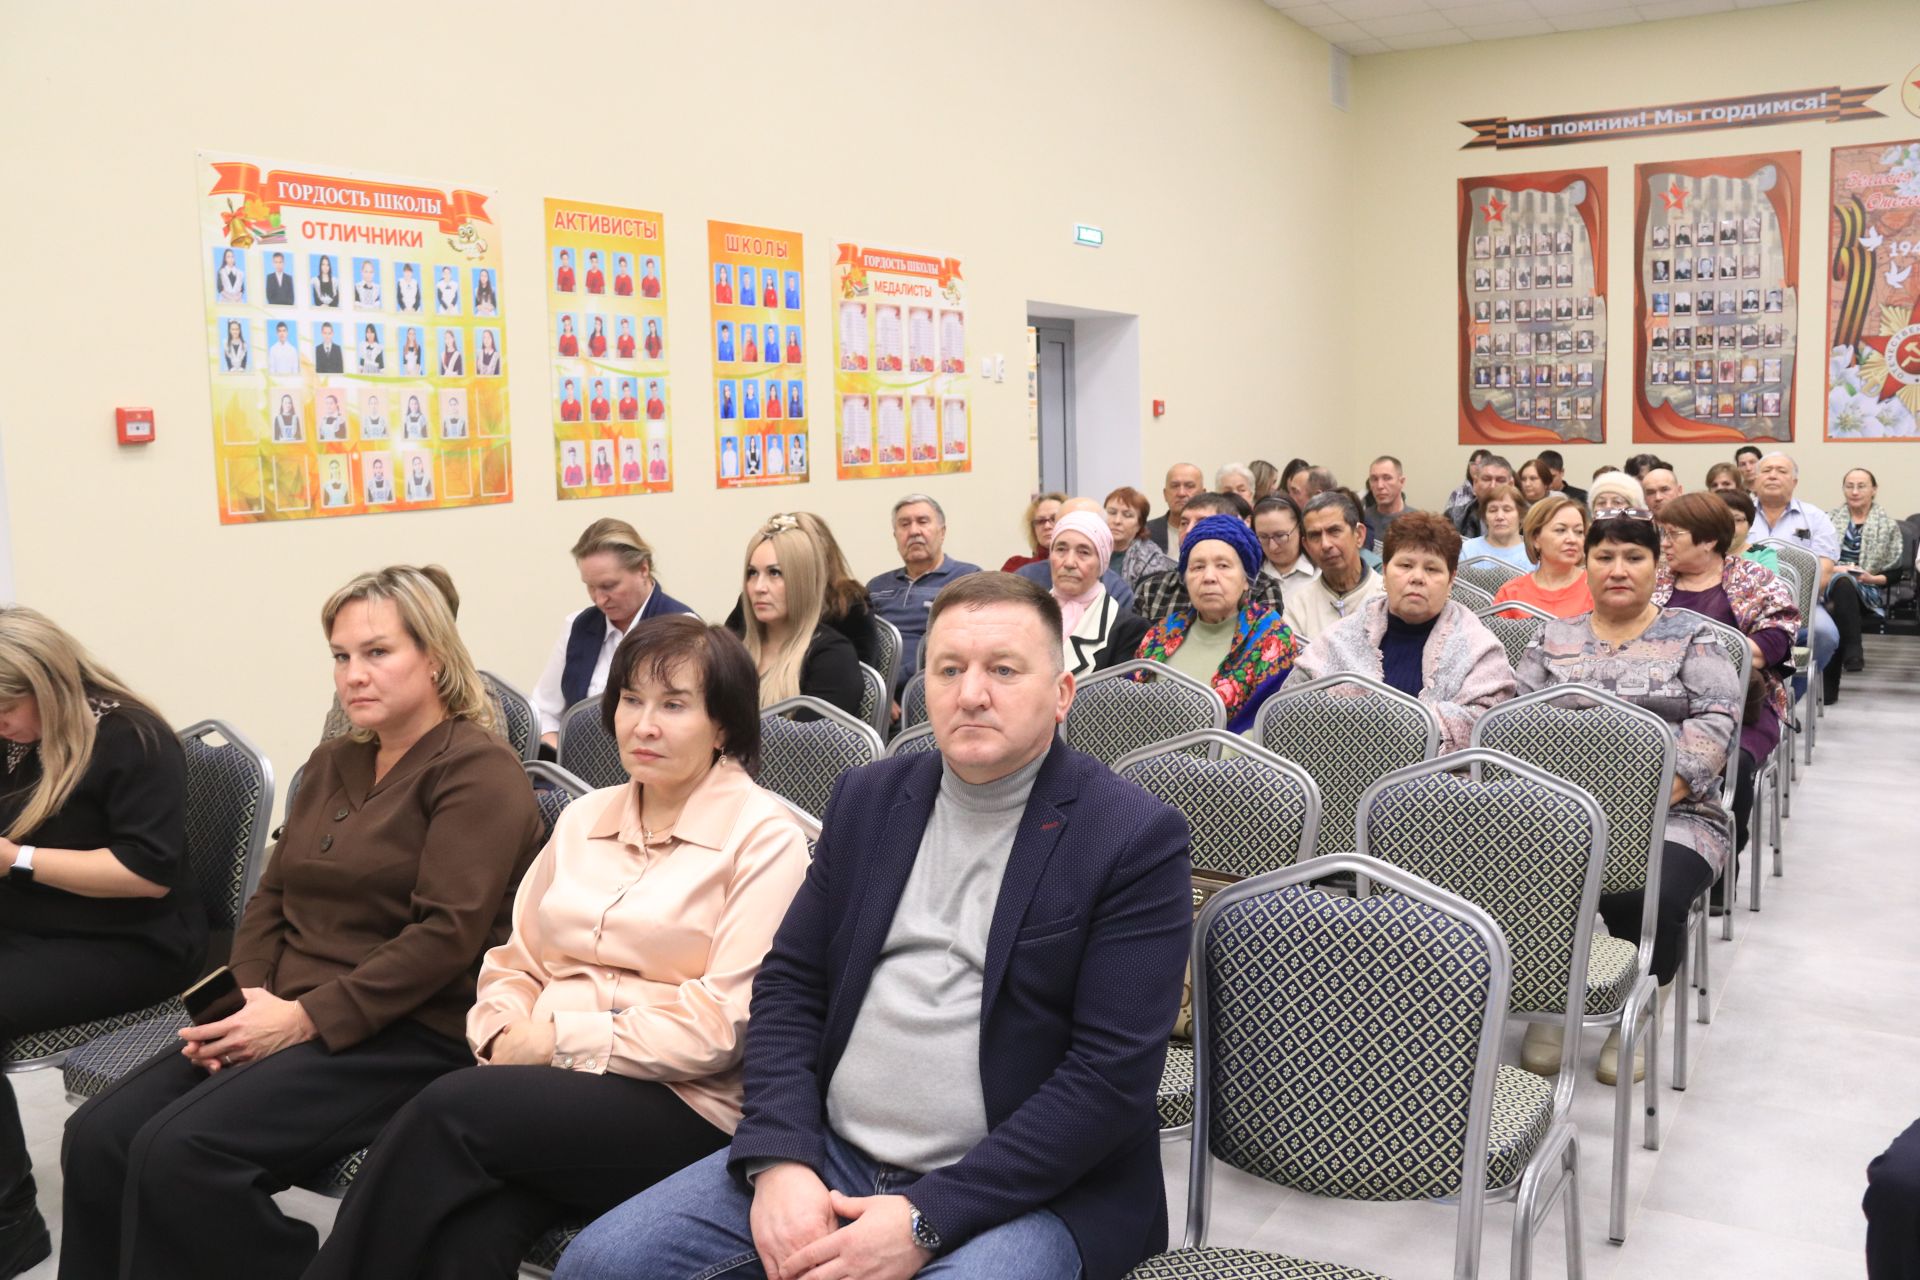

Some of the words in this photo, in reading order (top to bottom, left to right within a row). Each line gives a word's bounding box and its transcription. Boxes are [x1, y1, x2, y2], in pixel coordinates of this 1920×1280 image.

[1508, 123, 1544, 139] Мы
[1551, 111, 1646, 136] помним!
[1654, 108, 1693, 125] Мы
[1701, 92, 1827, 123] гордимся!
[278, 181, 370, 207] ГОРДОСТЬ
[373, 192, 442, 215] ШКОЛЫ
[301, 220, 423, 248] ОТЛИЧНИКИ
[554, 211, 657, 240] АКТИВИСТЫ
[725, 235, 788, 258] ШКОЛЫ
[863, 254, 907, 271] ГОРДОСТЬ
[907, 260, 939, 275] ШКОЛЫ
[874, 280, 932, 298] МЕДАЛИСТЫ
